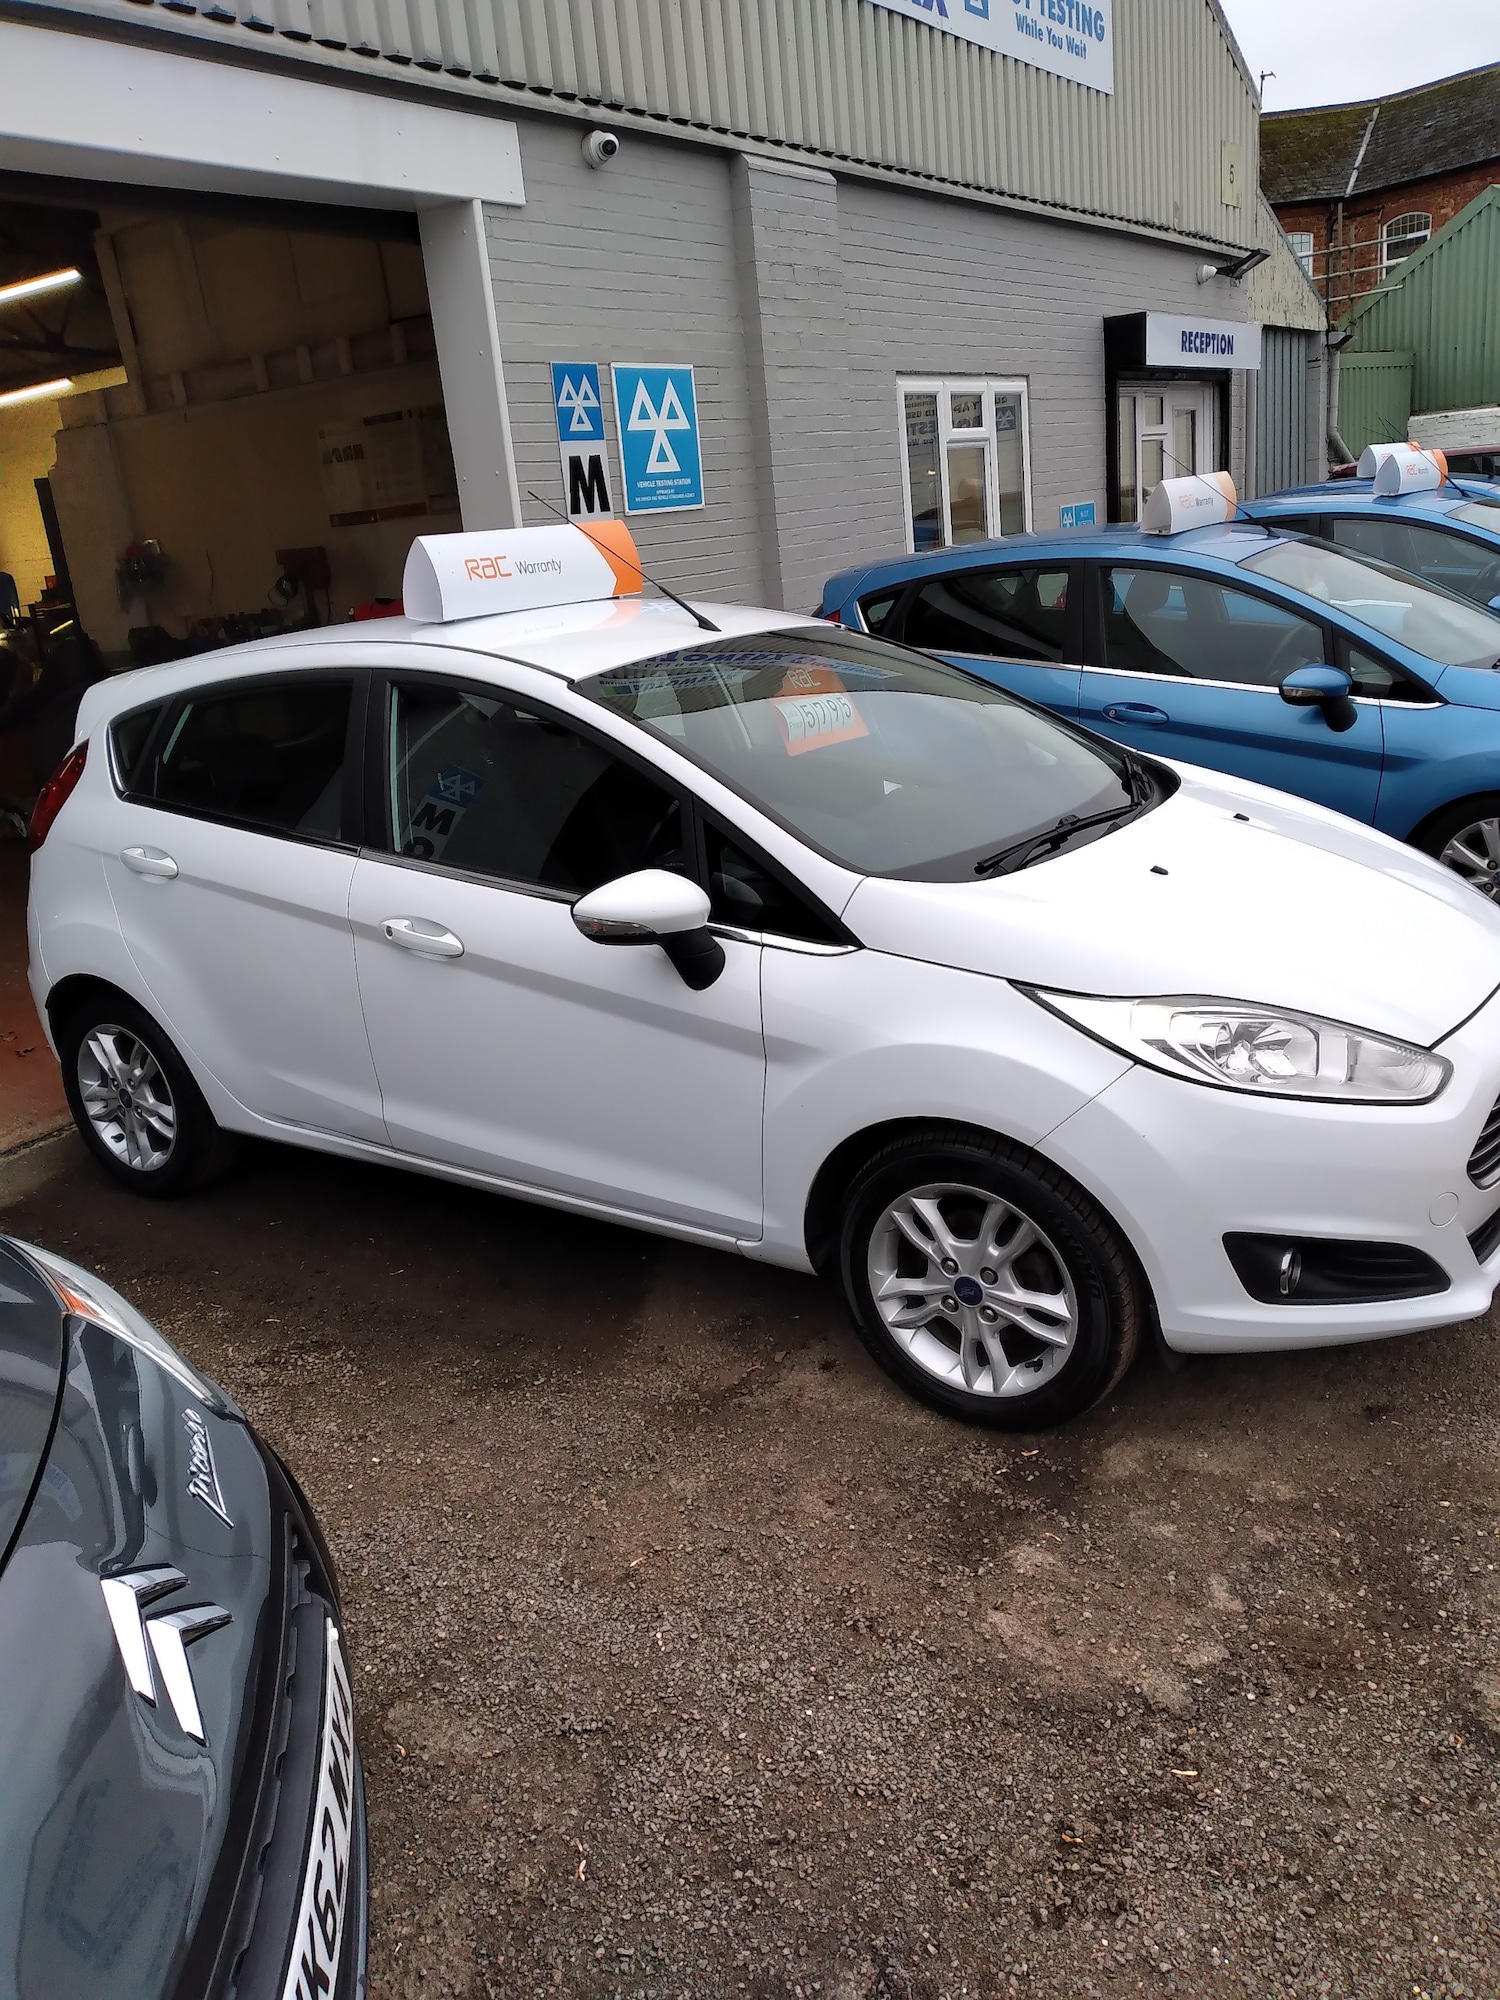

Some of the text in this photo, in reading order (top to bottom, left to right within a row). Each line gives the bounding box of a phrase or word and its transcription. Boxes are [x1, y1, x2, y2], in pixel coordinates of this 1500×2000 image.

[1015, 12, 1087, 60] While You Wait
[1229, 163, 1235, 185] 5
[1181, 330, 1234, 355] RECEPTION
[568, 454, 611, 515] M
[515, 558, 562, 575] Warranty
[800, 697, 852, 729] 5795
